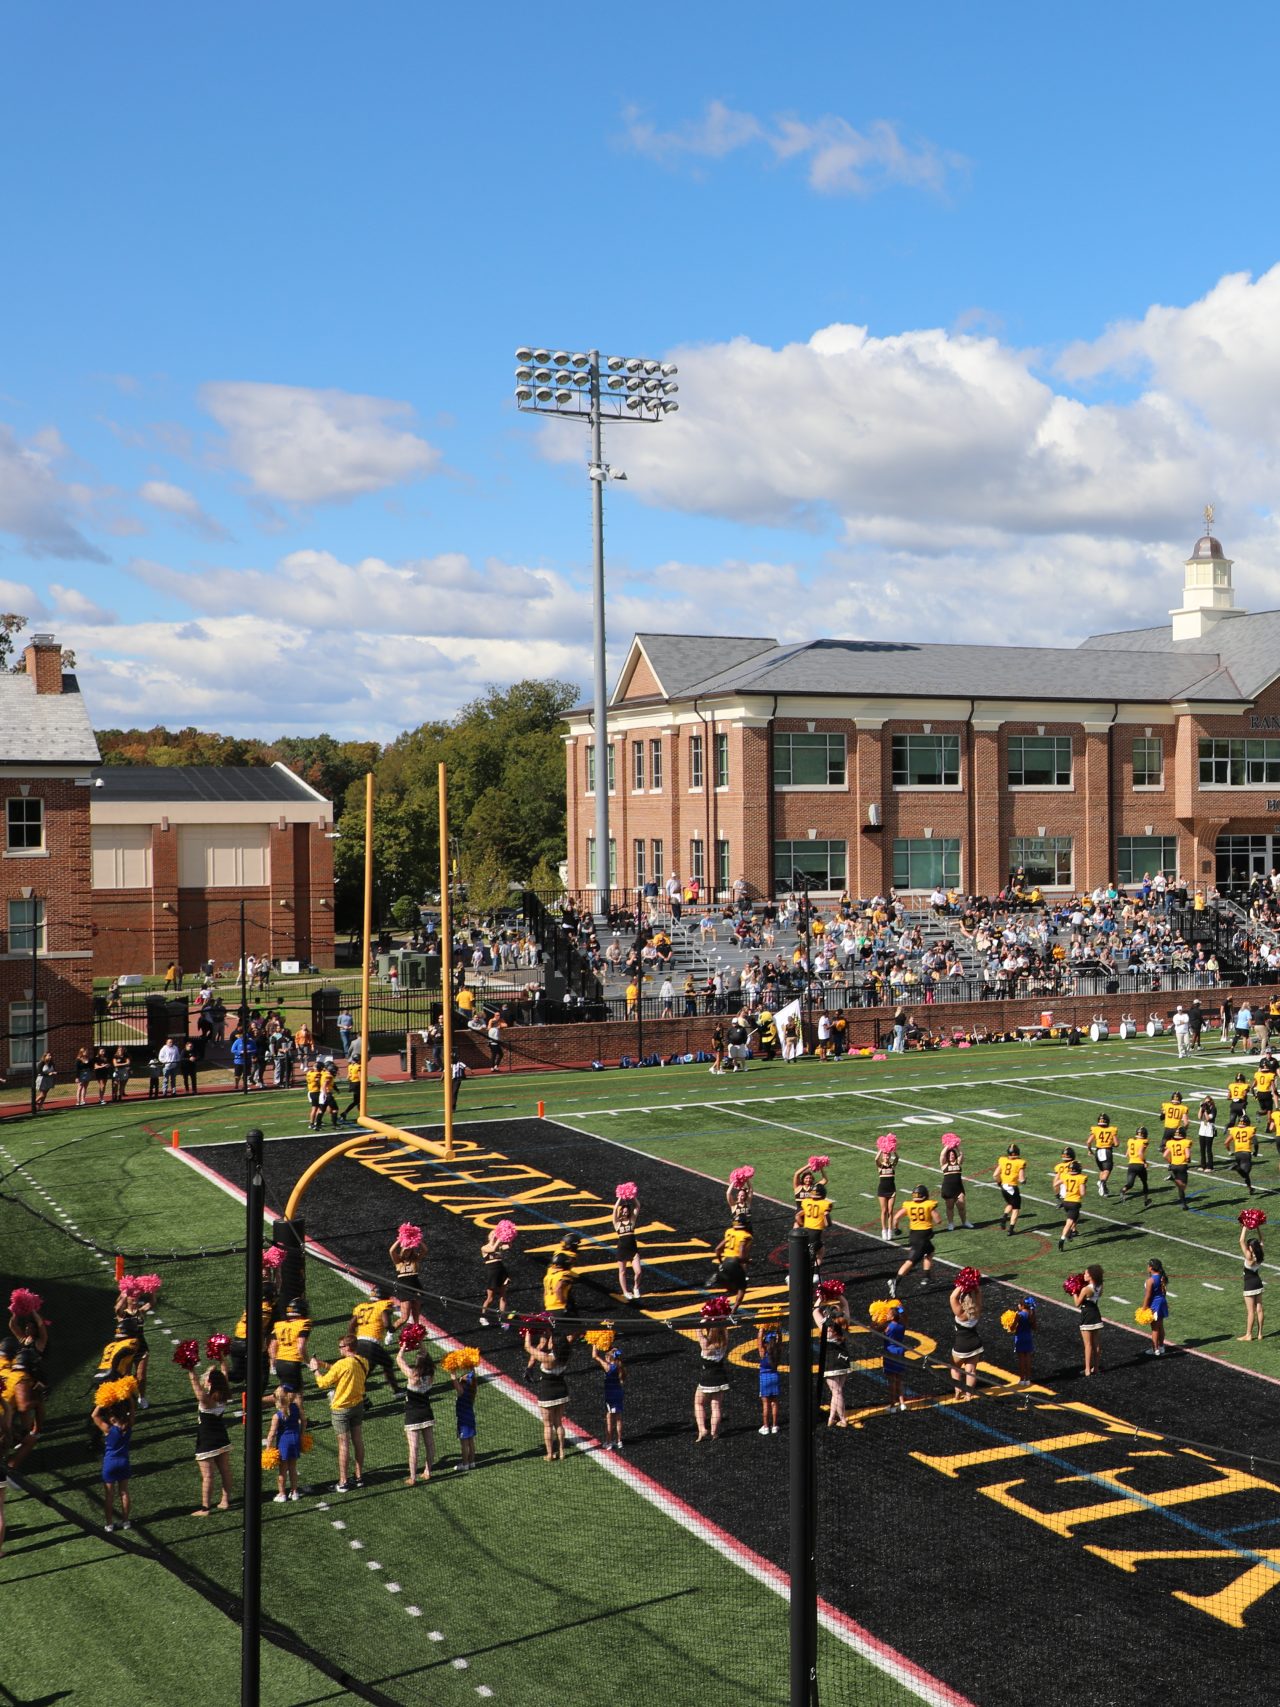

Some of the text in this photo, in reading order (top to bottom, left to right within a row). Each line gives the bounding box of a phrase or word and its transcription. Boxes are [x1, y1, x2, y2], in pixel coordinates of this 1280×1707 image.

[1259, 1076, 1265, 1086] 0
[1233, 1086, 1239, 1097] 6
[1168, 1108, 1180, 1120] 90
[1099, 1131, 1112, 1143] 47
[1235, 1131, 1248, 1142] 42
[1129, 1143, 1135, 1155] 9
[1172, 1144, 1182, 1156] 12
[1005, 1162, 1012, 1176] 8
[1066, 1179, 1076, 1192] 17
[807, 1203, 820, 1219] 30
[911, 1207, 925, 1222] 58
